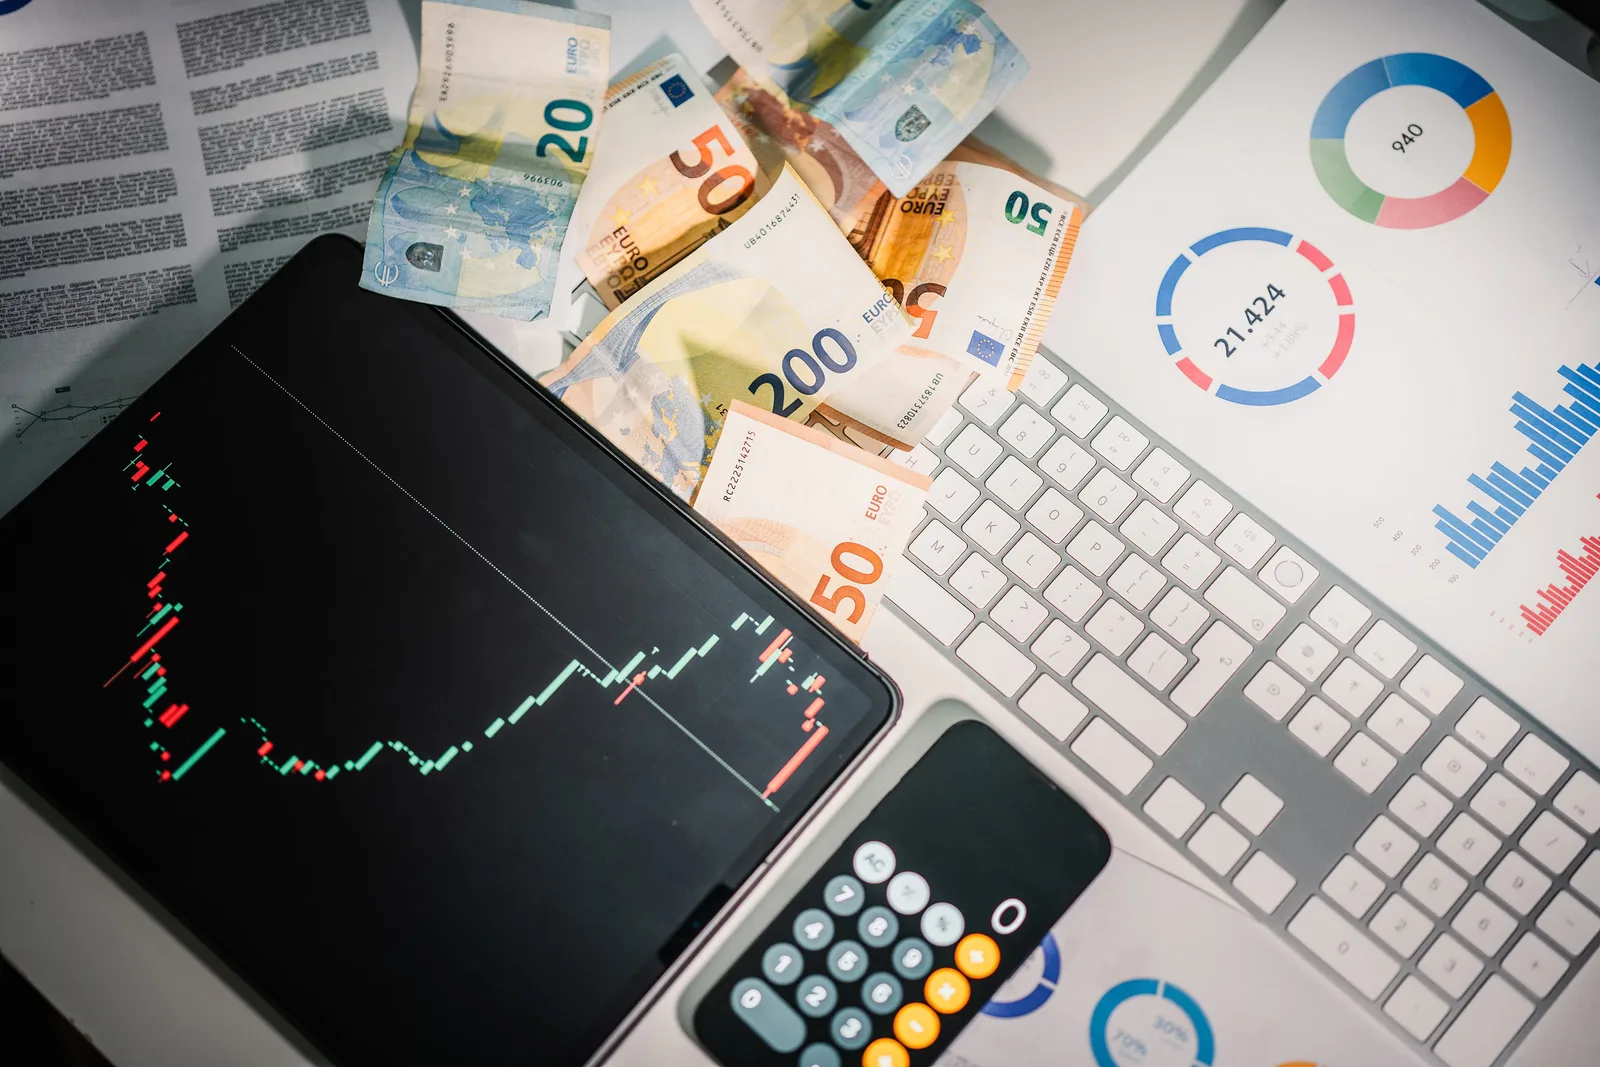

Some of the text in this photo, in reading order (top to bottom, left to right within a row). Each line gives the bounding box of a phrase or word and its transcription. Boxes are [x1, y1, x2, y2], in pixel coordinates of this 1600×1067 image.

[566, 37, 578, 74] EURO
[535, 98, 593, 163] 20
[1392, 124, 1423, 154] 940
[669, 124, 755, 215] 50
[523, 173, 563, 188] 903996
[900, 201, 946, 215] EURO
[1005, 190, 1053, 237] 50
[744, 193, 800, 249] UB4016874431
[1058, 214, 1067, 228] BCE
[1053, 229, 1061, 242] ECB
[612, 226, 649, 271] EURO
[1044, 257, 1053, 272] EZB
[1039, 272, 1047, 287] EKP
[1020, 316, 1030, 332] EKB
[1214, 283, 1286, 358] 21.424
[1008, 347, 1018, 363] EBC
[748, 327, 858, 418] 200
[1028, 382, 1037, 390] F7
[897, 372, 944, 429] UB1857310823
[977, 399, 988, 408] 7
[1016, 431, 1027, 442] 8
[968, 444, 980, 456] U
[1109, 446, 1117, 454] F9
[723, 430, 756, 502] RC2225142715
[905, 456, 918, 468] H
[1056, 462, 1067, 473] 9
[1149, 477, 1160, 487] F10
[945, 491, 957, 499] J
[865, 484, 888, 521] EURO
[985, 521, 998, 534] K
[1373, 516, 1385, 529] 500
[1392, 530, 1404, 542] 400
[930, 540, 945, 554] M
[1090, 542, 1101, 551] P
[1410, 544, 1422, 556] 300
[1026, 554, 1034, 566] L
[1429, 558, 1441, 570] 200
[809, 541, 884, 625] 50
[1448, 573, 1459, 585] 100
[1414, 800, 1427, 810] 7
[1381, 841, 1392, 852] 4
[1462, 837, 1475, 851] 8
[864, 853, 886, 873] AC
[1512, 876, 1525, 890] 9
[834, 885, 855, 903] 7
[991, 897, 1027, 935] 0
[805, 985, 827, 1008] 2
[1153, 1015, 1189, 1042] 30%
[1112, 1028, 1148, 1057] 70%
